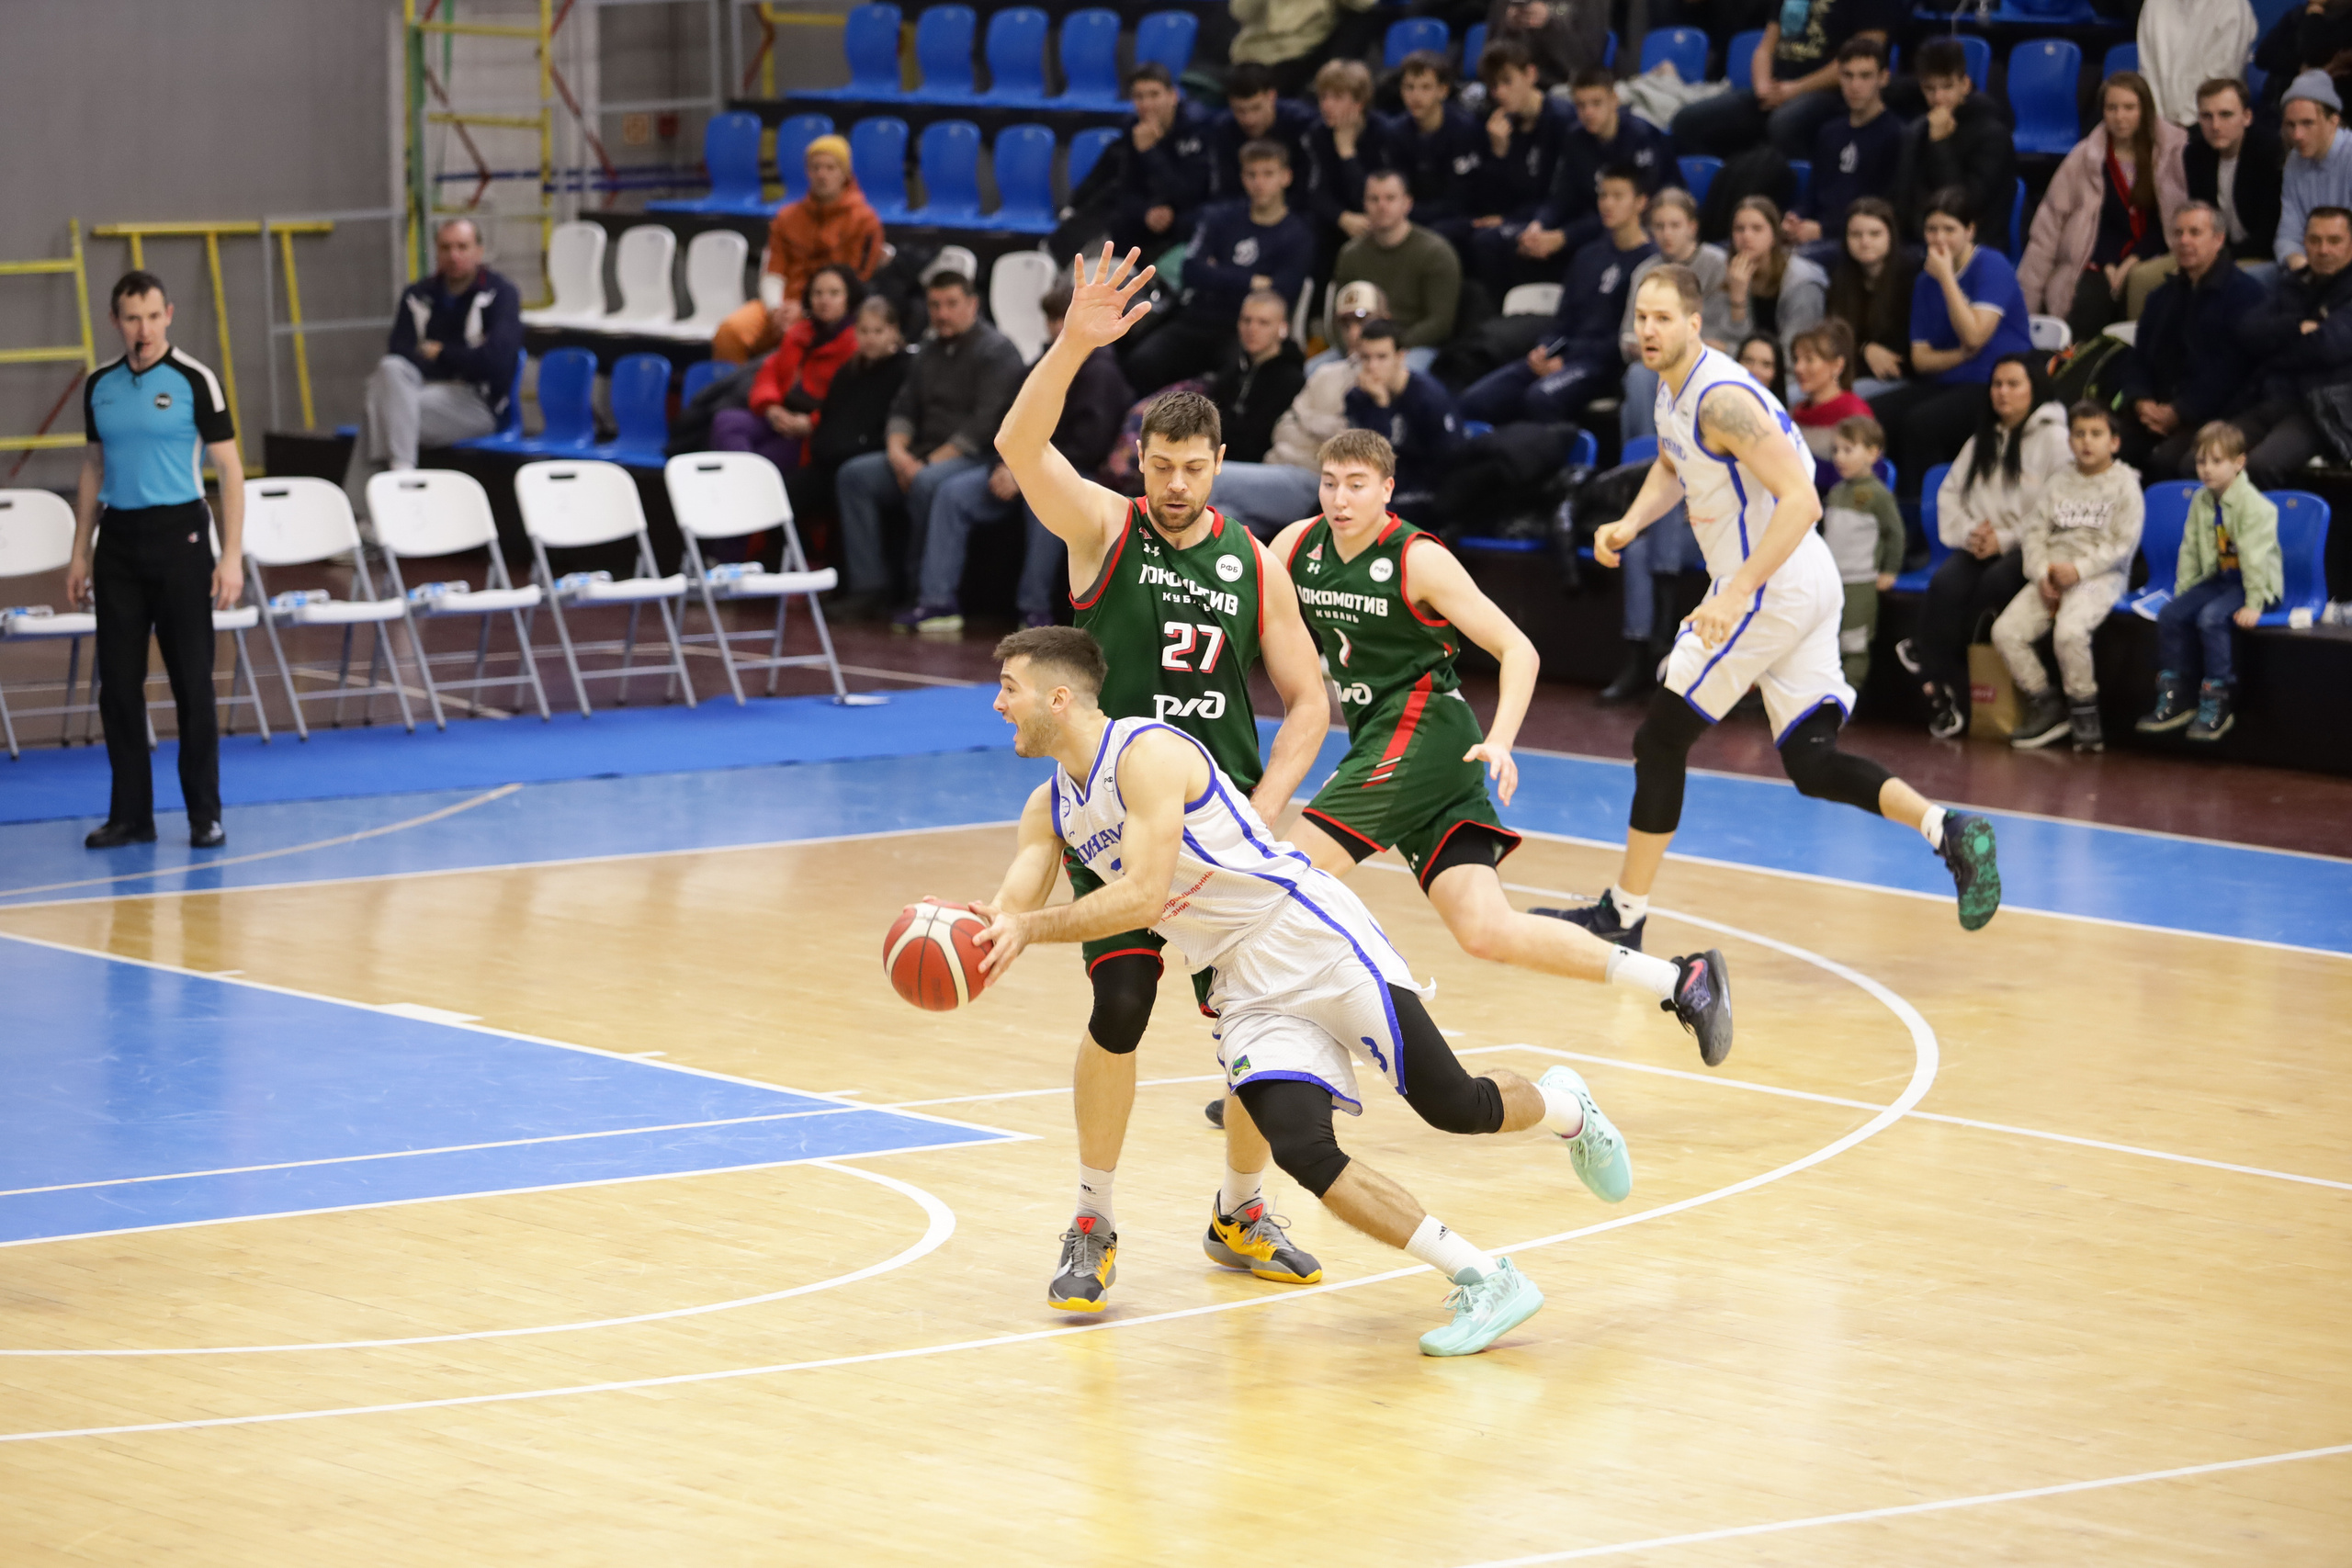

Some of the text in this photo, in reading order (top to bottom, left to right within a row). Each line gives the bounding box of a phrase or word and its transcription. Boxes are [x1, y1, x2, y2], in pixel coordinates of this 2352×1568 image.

[1220, 563, 1238, 573] РФБ
[1139, 564, 1238, 616] ЛОКООИВ
[1162, 592, 1211, 612] КУБЬ
[1316, 609, 1360, 624] КУБАНЬ
[1161, 621, 1226, 673] 27
